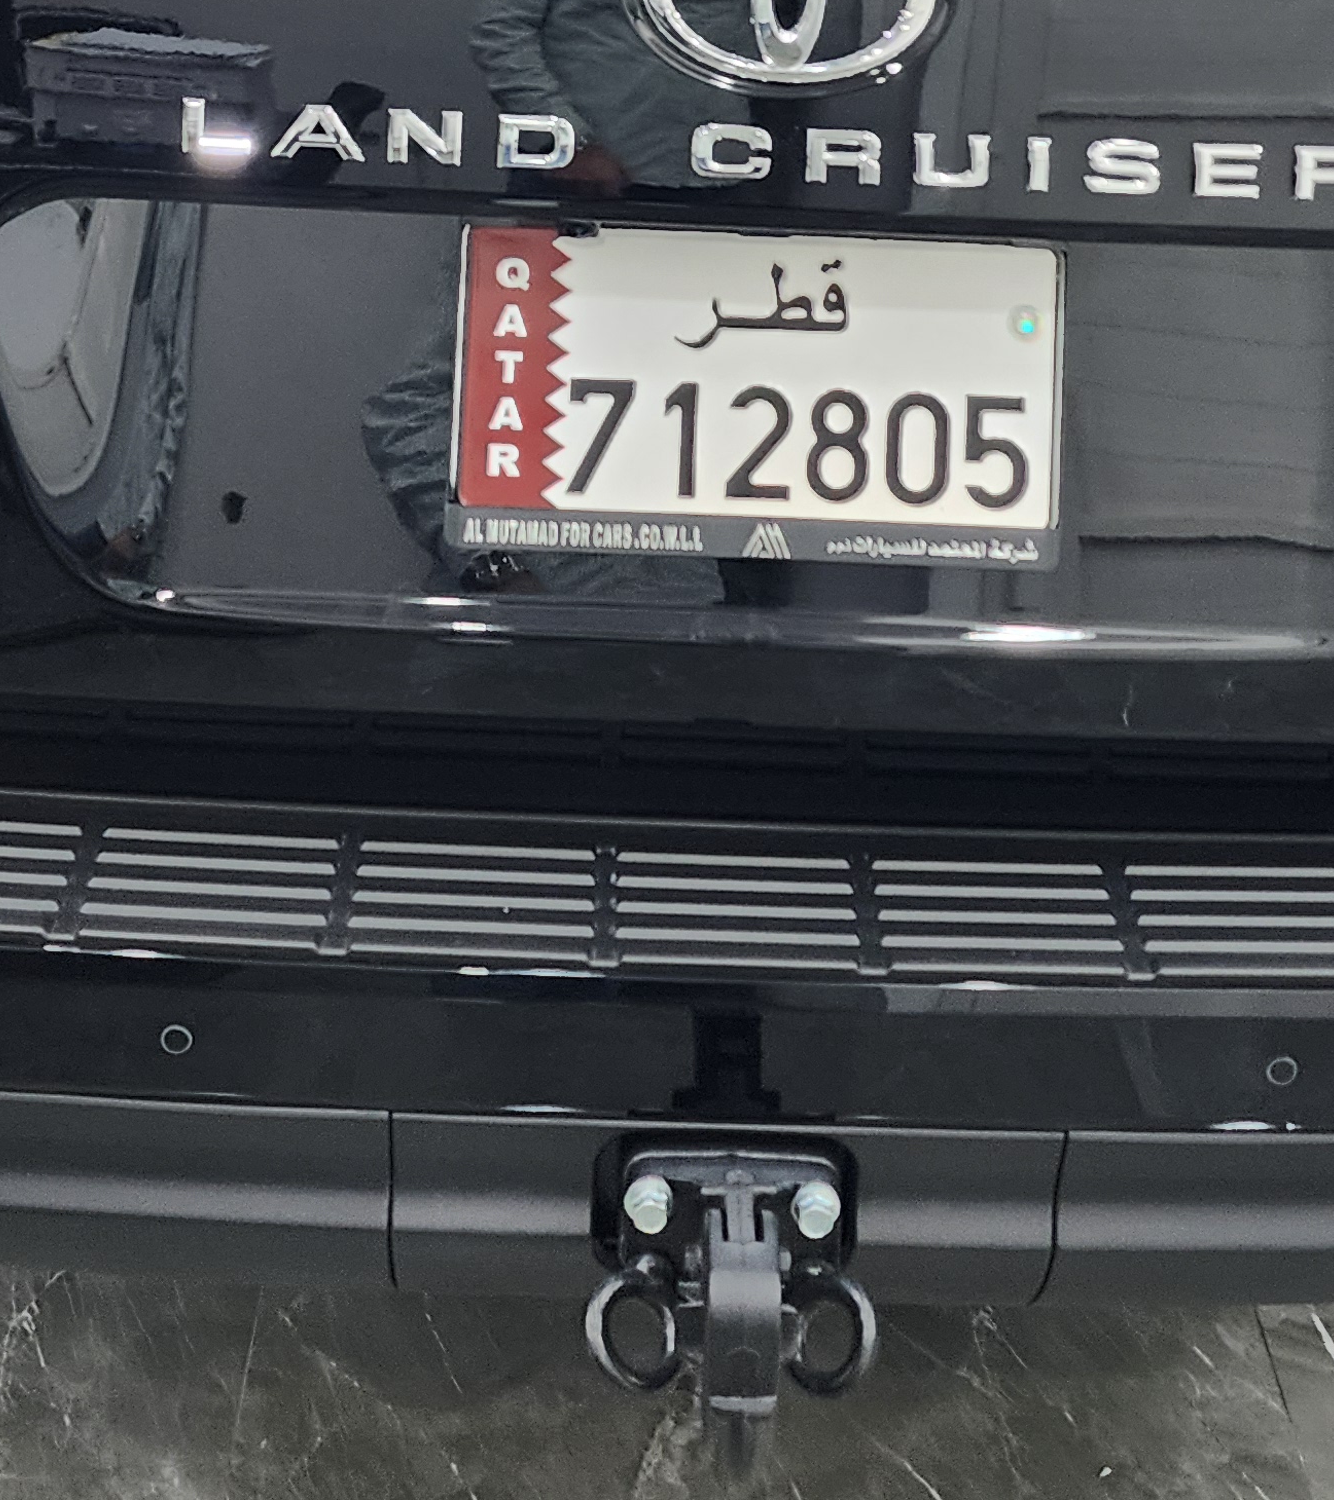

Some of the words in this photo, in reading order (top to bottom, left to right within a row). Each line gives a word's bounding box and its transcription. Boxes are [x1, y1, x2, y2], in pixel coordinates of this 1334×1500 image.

[182, 97, 575, 168] LAND
[675, 260, 848, 349] قطر
[486, 257, 531, 477] QATAR
[567, 378, 1028, 509] 712805
[462, 517, 483, 544] AL
[485, 519, 559, 547] MUTAMAD
[560, 521, 590, 547] FOR
